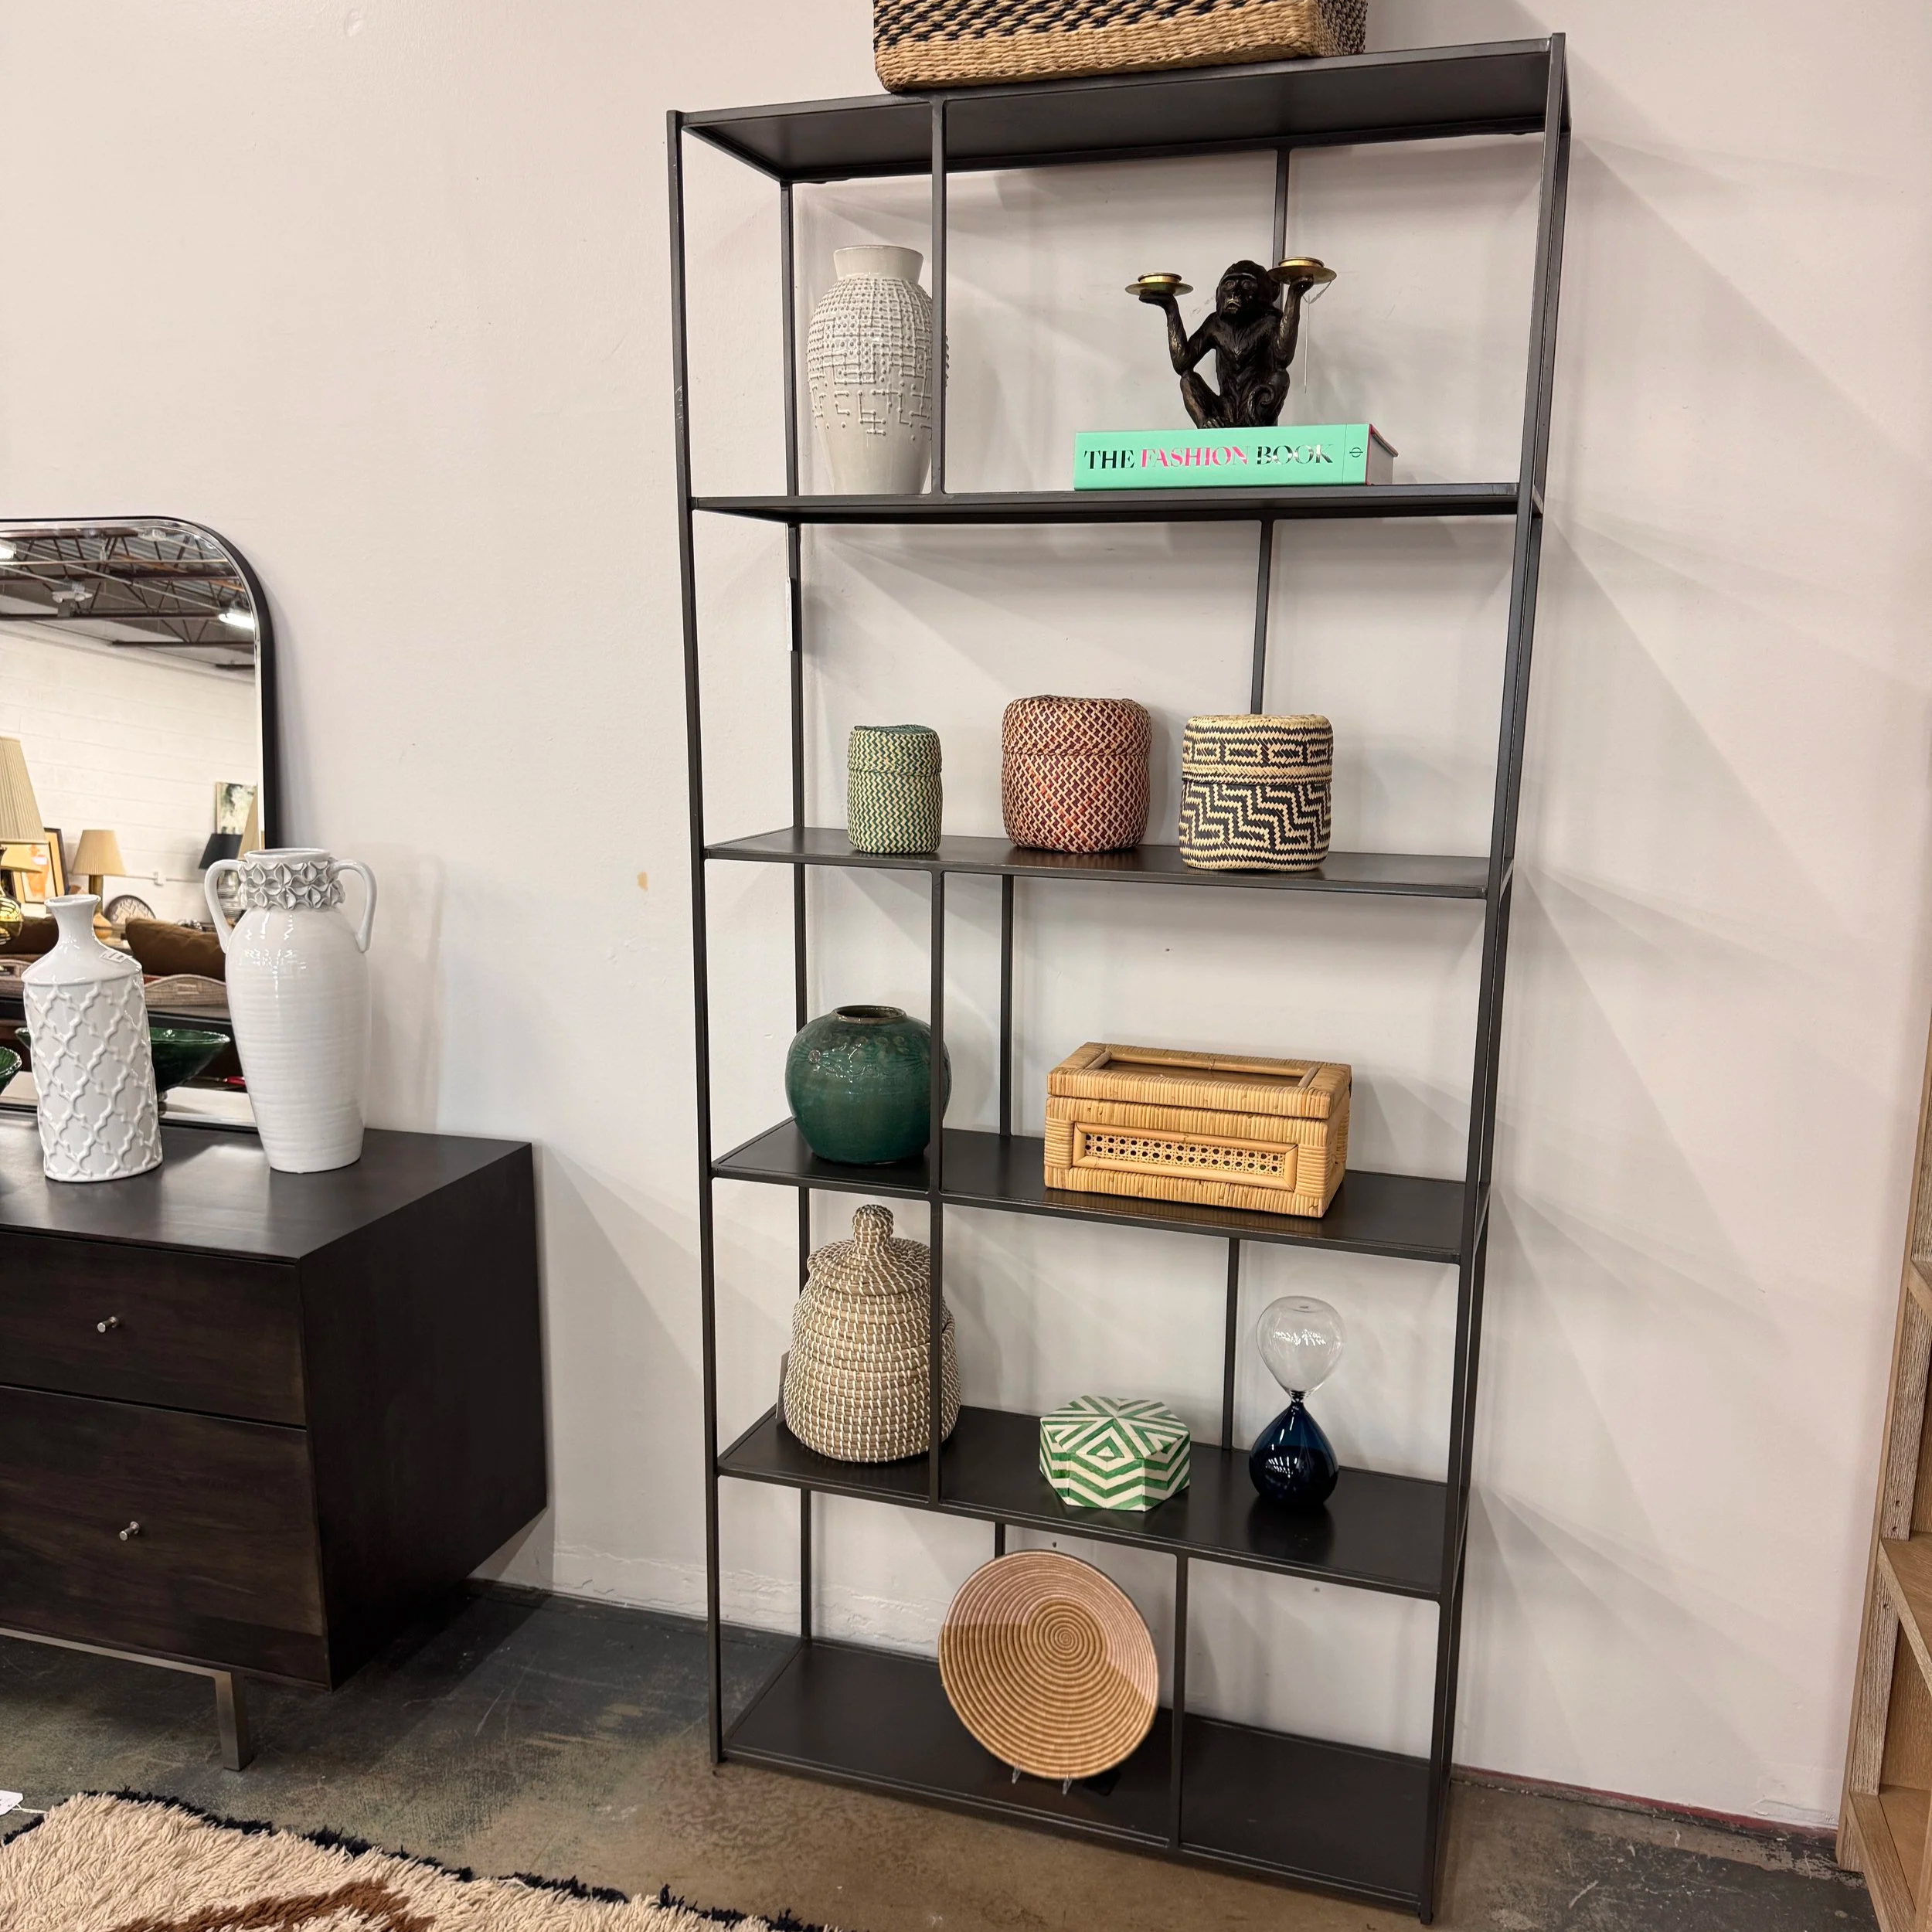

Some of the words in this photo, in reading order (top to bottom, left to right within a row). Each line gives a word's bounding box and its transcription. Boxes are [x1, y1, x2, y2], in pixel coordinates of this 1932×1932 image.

[1083, 449, 1134, 469] THE
[1140, 445, 1250, 468] FASHION
[1256, 443, 1334, 465] BOOK
